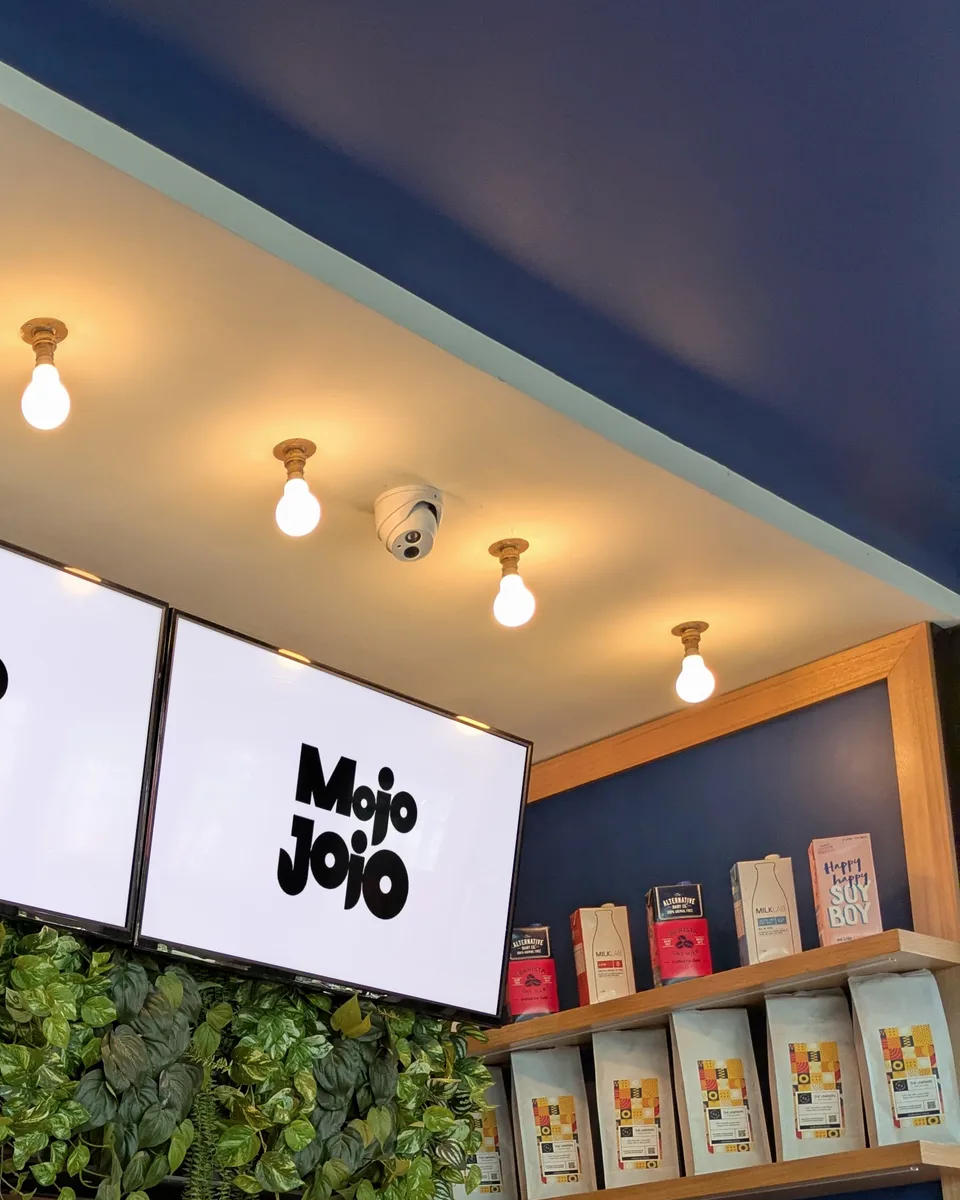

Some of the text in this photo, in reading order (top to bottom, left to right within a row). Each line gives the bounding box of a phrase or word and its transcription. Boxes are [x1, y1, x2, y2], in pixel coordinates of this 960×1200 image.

[295, 743, 418, 845] Mojo
[824, 858, 861, 875] Happy
[833, 872, 868, 887] happy
[663, 896, 695, 906] ALTERNATIVE
[829, 880, 871, 906] SOY
[756, 905, 786, 914] MILKLAB
[827, 902, 871, 928] BOY
[513, 938, 544, 947] ALTERNATIVE
